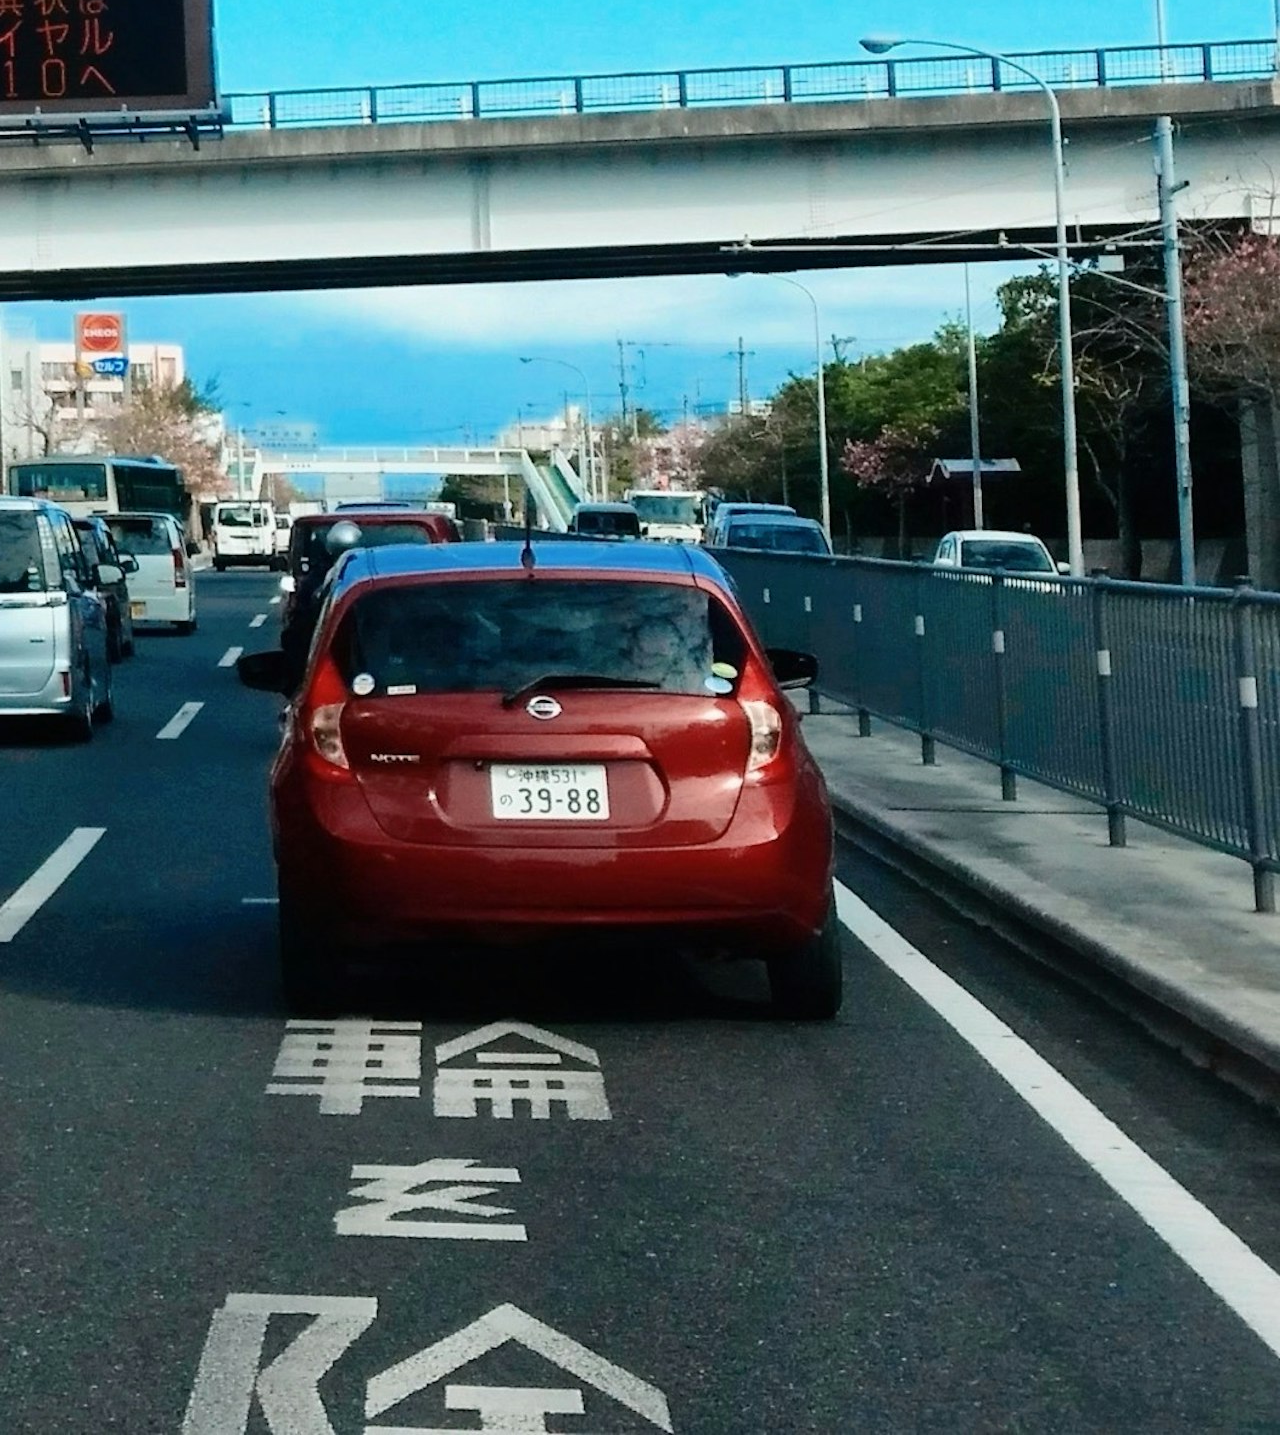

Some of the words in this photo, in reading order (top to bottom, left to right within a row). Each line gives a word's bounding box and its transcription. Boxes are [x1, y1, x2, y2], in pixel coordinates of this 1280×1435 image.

[83, 328, 118, 338] ENEOS
[94, 360, 124, 372] セルフ
[371, 754, 420, 763] NOTE
[518, 788, 600, 814] 39-88
